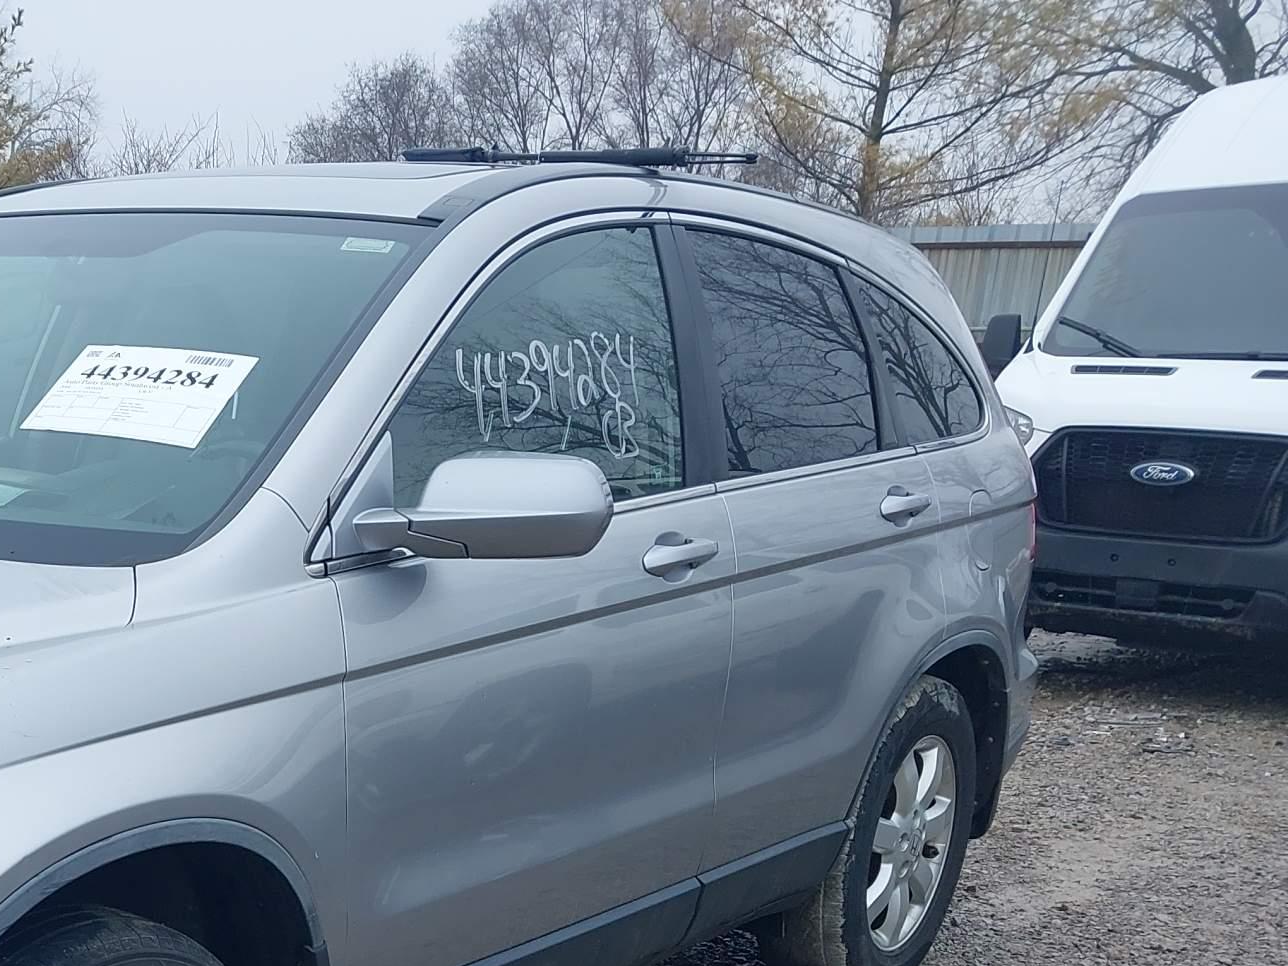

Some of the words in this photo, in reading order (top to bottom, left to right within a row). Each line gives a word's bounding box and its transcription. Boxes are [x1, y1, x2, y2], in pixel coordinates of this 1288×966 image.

[81, 364, 221, 389] 44394284
[455, 331, 639, 437] 44394284
[1143, 465, 1179, 480] Ford
